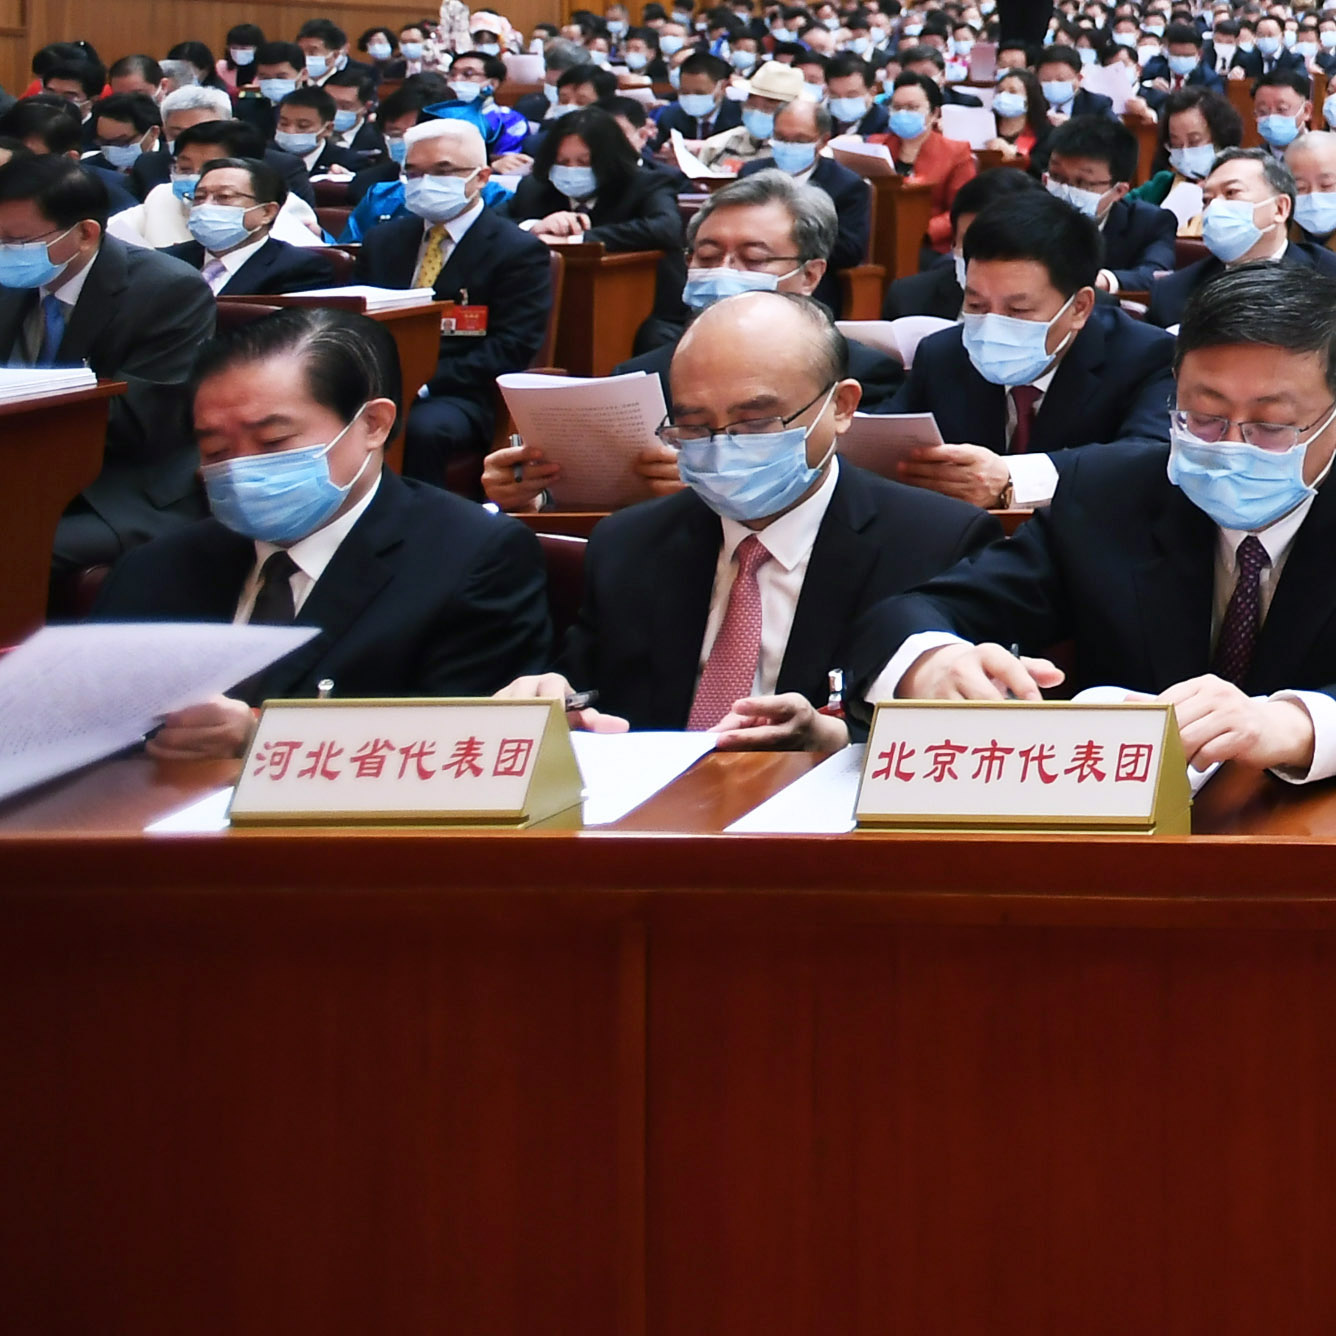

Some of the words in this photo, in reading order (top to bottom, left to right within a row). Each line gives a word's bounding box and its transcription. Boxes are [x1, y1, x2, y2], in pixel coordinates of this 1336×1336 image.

[252, 736, 534, 781] 河北省代表团
[871, 739, 1154, 785] 北京市代表团
